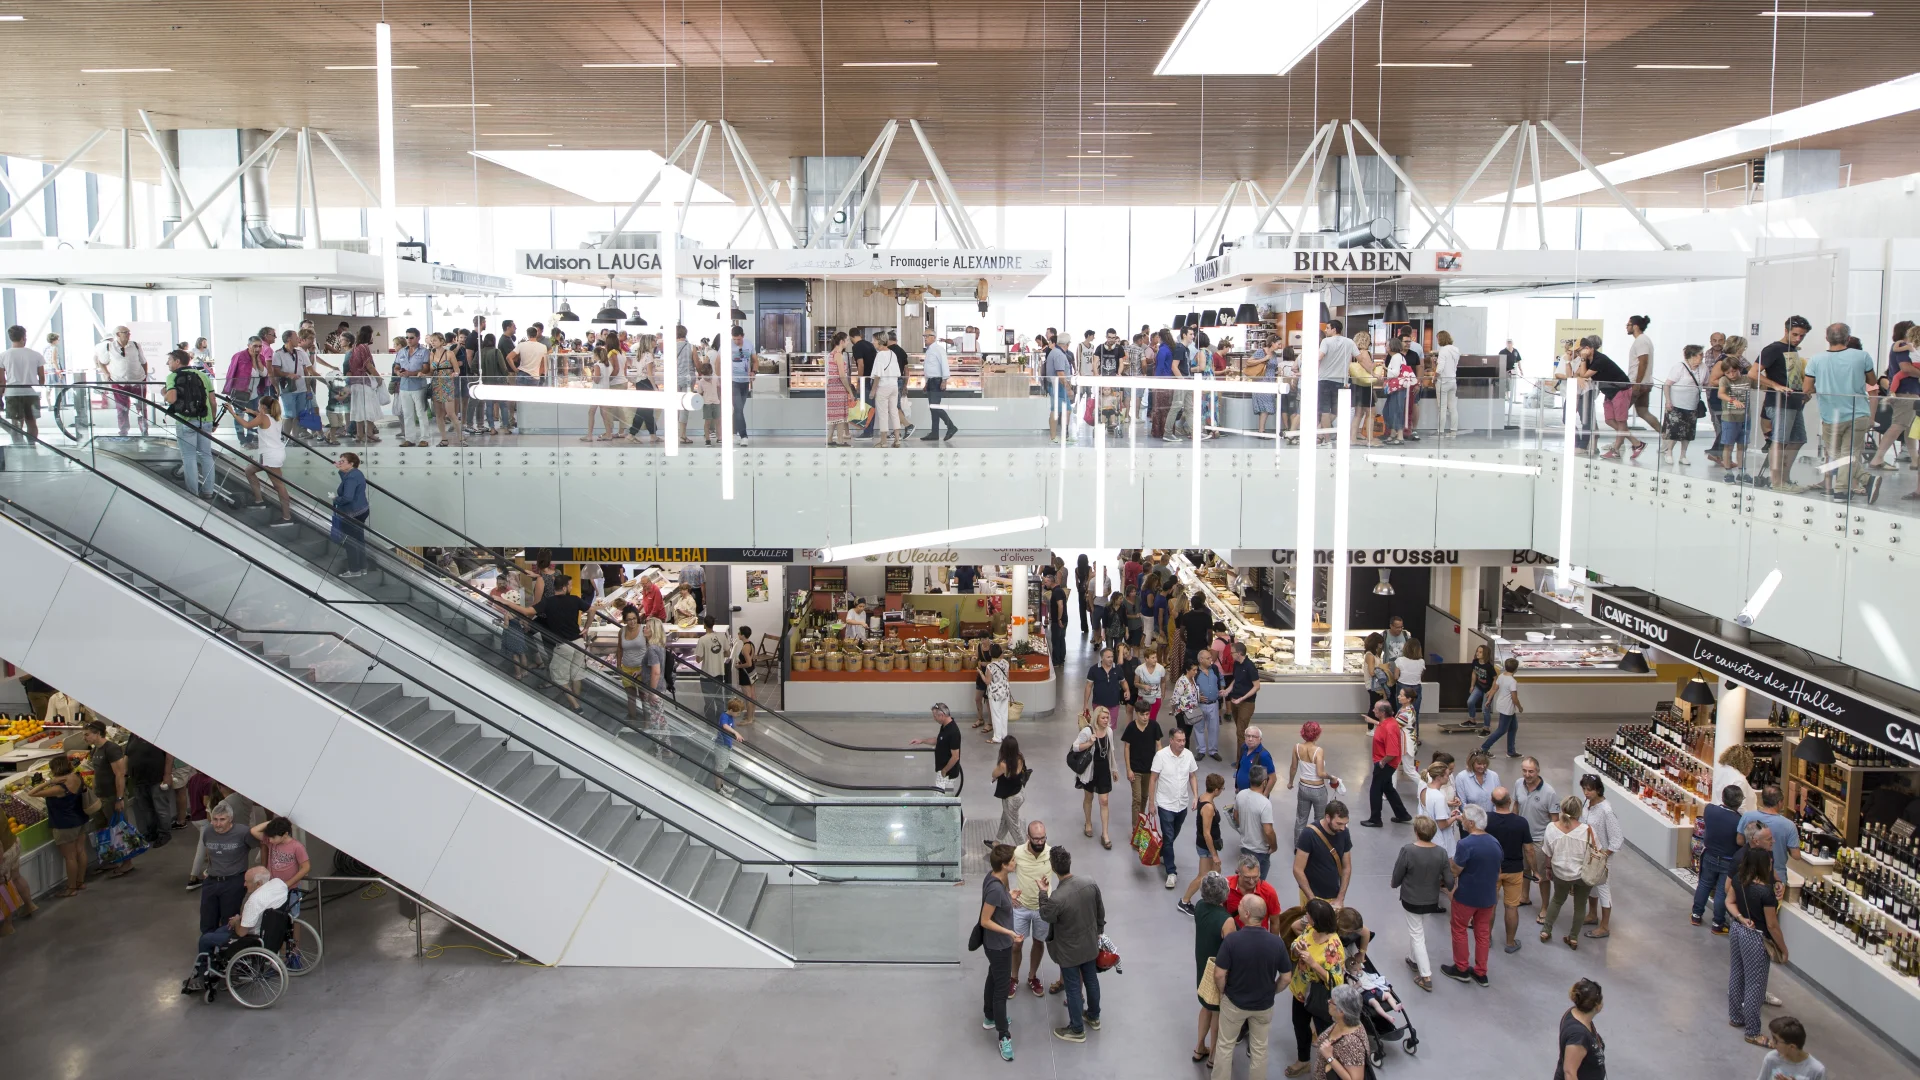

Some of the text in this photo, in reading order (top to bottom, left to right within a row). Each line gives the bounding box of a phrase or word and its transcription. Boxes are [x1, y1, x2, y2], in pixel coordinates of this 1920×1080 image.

[526, 253, 662, 270] Maison LAUGA
[890, 255, 1022, 269] Fromagerie ALEXANDRE
[1294, 251, 1413, 272] BIRABEN
[572, 547, 708, 562] MAISON BALLERAT
[742, 549, 788, 558] VOLAILLER
[1000, 553, 1035, 562] d'olives
[1271, 548, 1459, 565] Crmeie d'Ossau
[1604, 605, 1668, 642] CAVE THOU
[1693, 639, 1846, 715] Les cavistes des Halles
